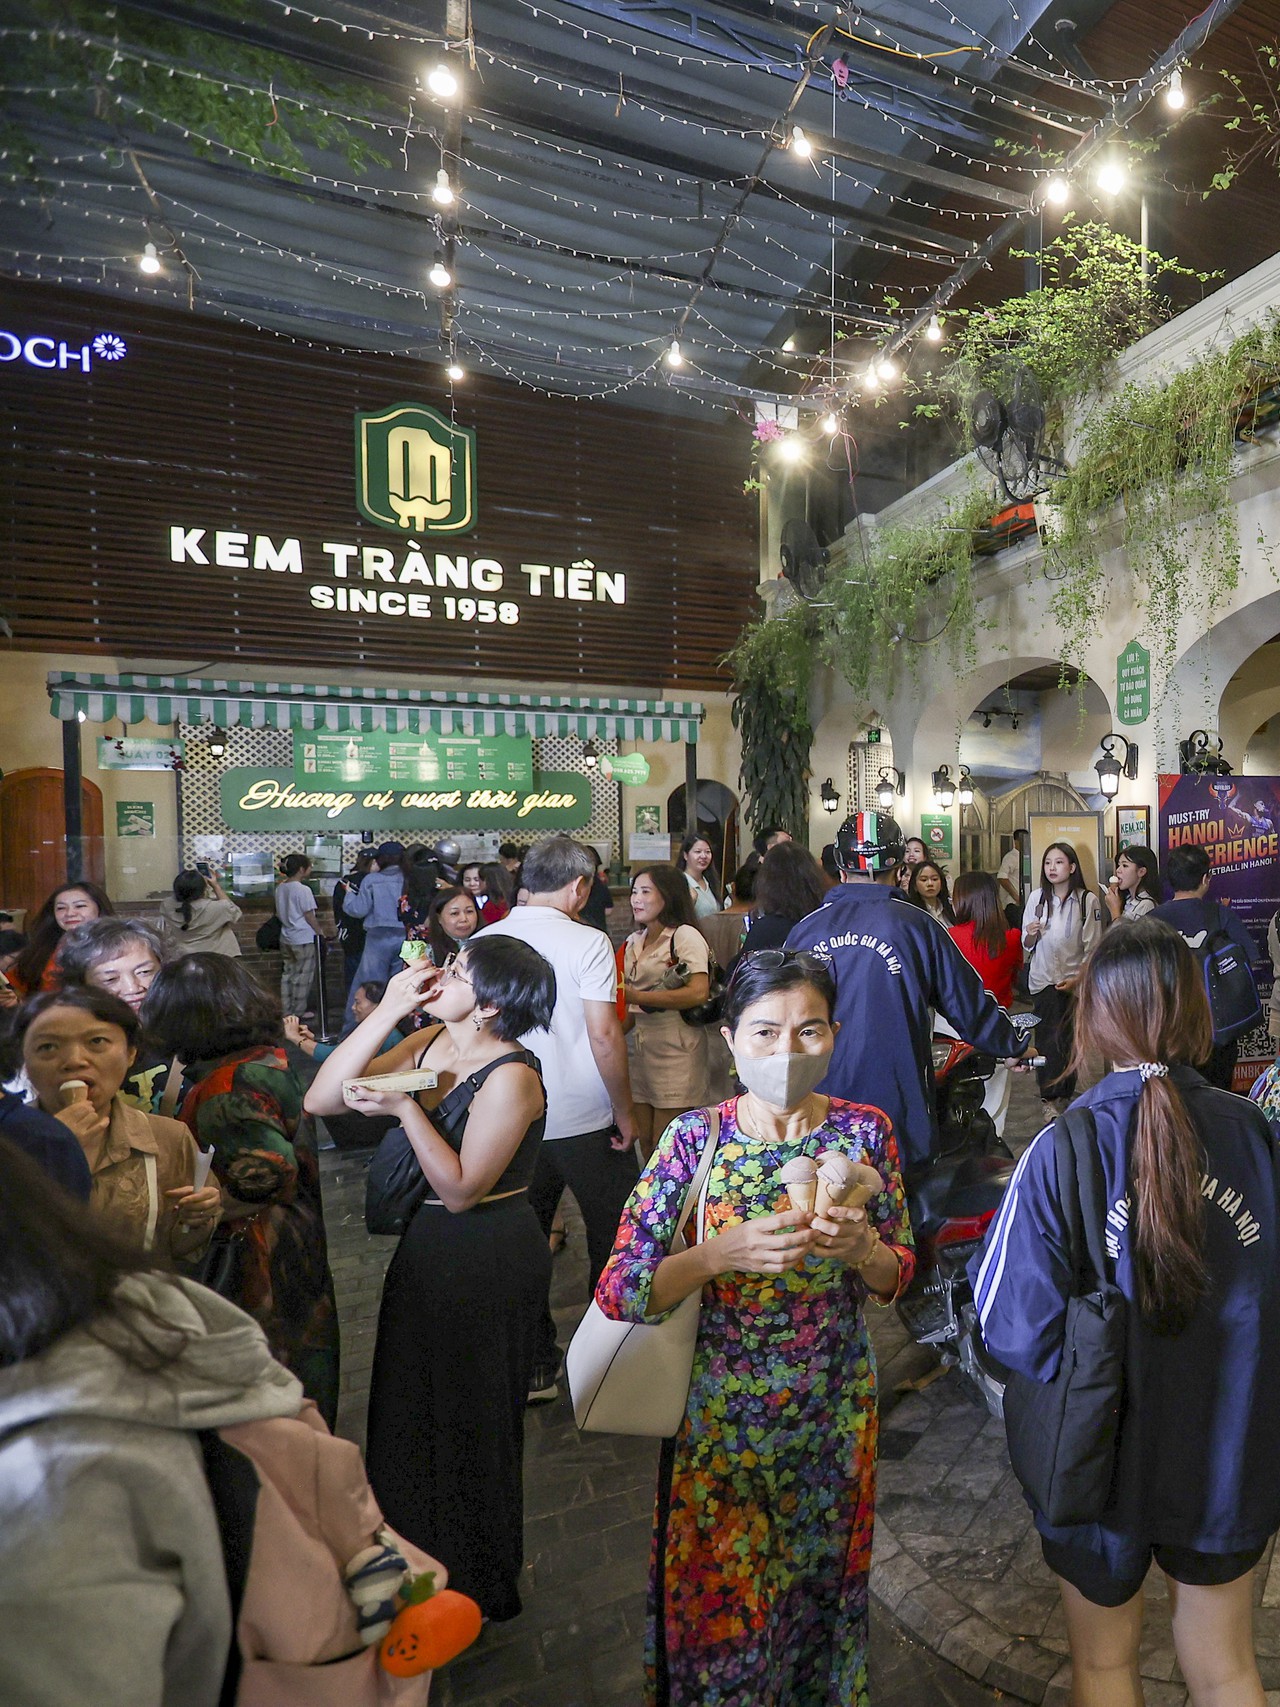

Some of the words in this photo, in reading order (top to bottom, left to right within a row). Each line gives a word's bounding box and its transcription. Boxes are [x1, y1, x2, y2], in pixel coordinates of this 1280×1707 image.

[169, 525, 303, 574] KEM
[321, 539, 505, 593] TRÀNG
[519, 558, 626, 605] TIỀN
[309, 585, 432, 617] SINCE
[443, 595, 521, 626] 1958
[517, 789, 577, 818] gian
[1168, 808, 1211, 826] MUST-TRY
[1168, 819, 1225, 850] HANOI
[1203, 833, 1279, 866] ERIENCE
[1209, 863, 1241, 876] ETBALL
[1241, 861, 1249, 870] IN
[1250, 858, 1273, 868] HANOI
[829, 930, 859, 949] QUỐC
[860, 934, 878, 949] GIA
[875, 941, 893, 959] HÀ
[1216, 1187, 1244, 1219] HÀ
[1235, 1210, 1261, 1248] NỘI
